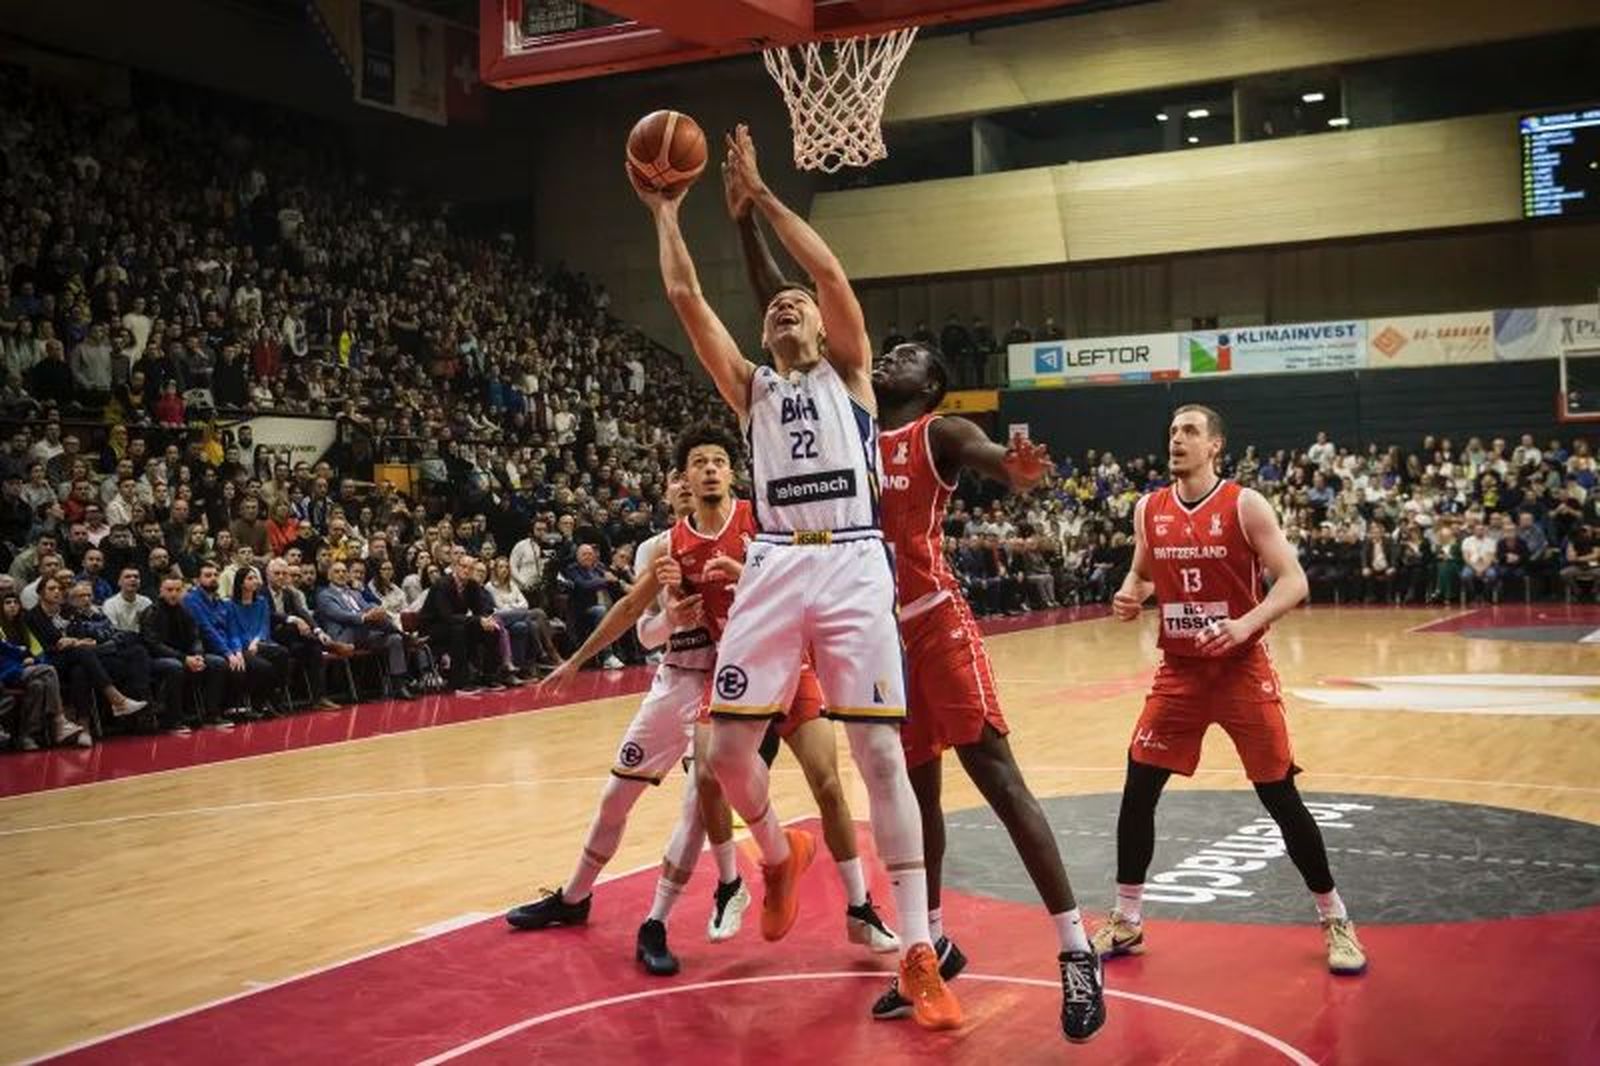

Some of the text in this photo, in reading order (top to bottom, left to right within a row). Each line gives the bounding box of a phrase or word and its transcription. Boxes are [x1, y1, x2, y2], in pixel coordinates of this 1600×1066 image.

[1237, 324, 1356, 344] KLIMAINVEST
[1066, 345, 1150, 367] LEFTOR
[789, 429, 819, 460] 22
[775, 477, 849, 499] telemach
[1180, 568, 1202, 593] 13
